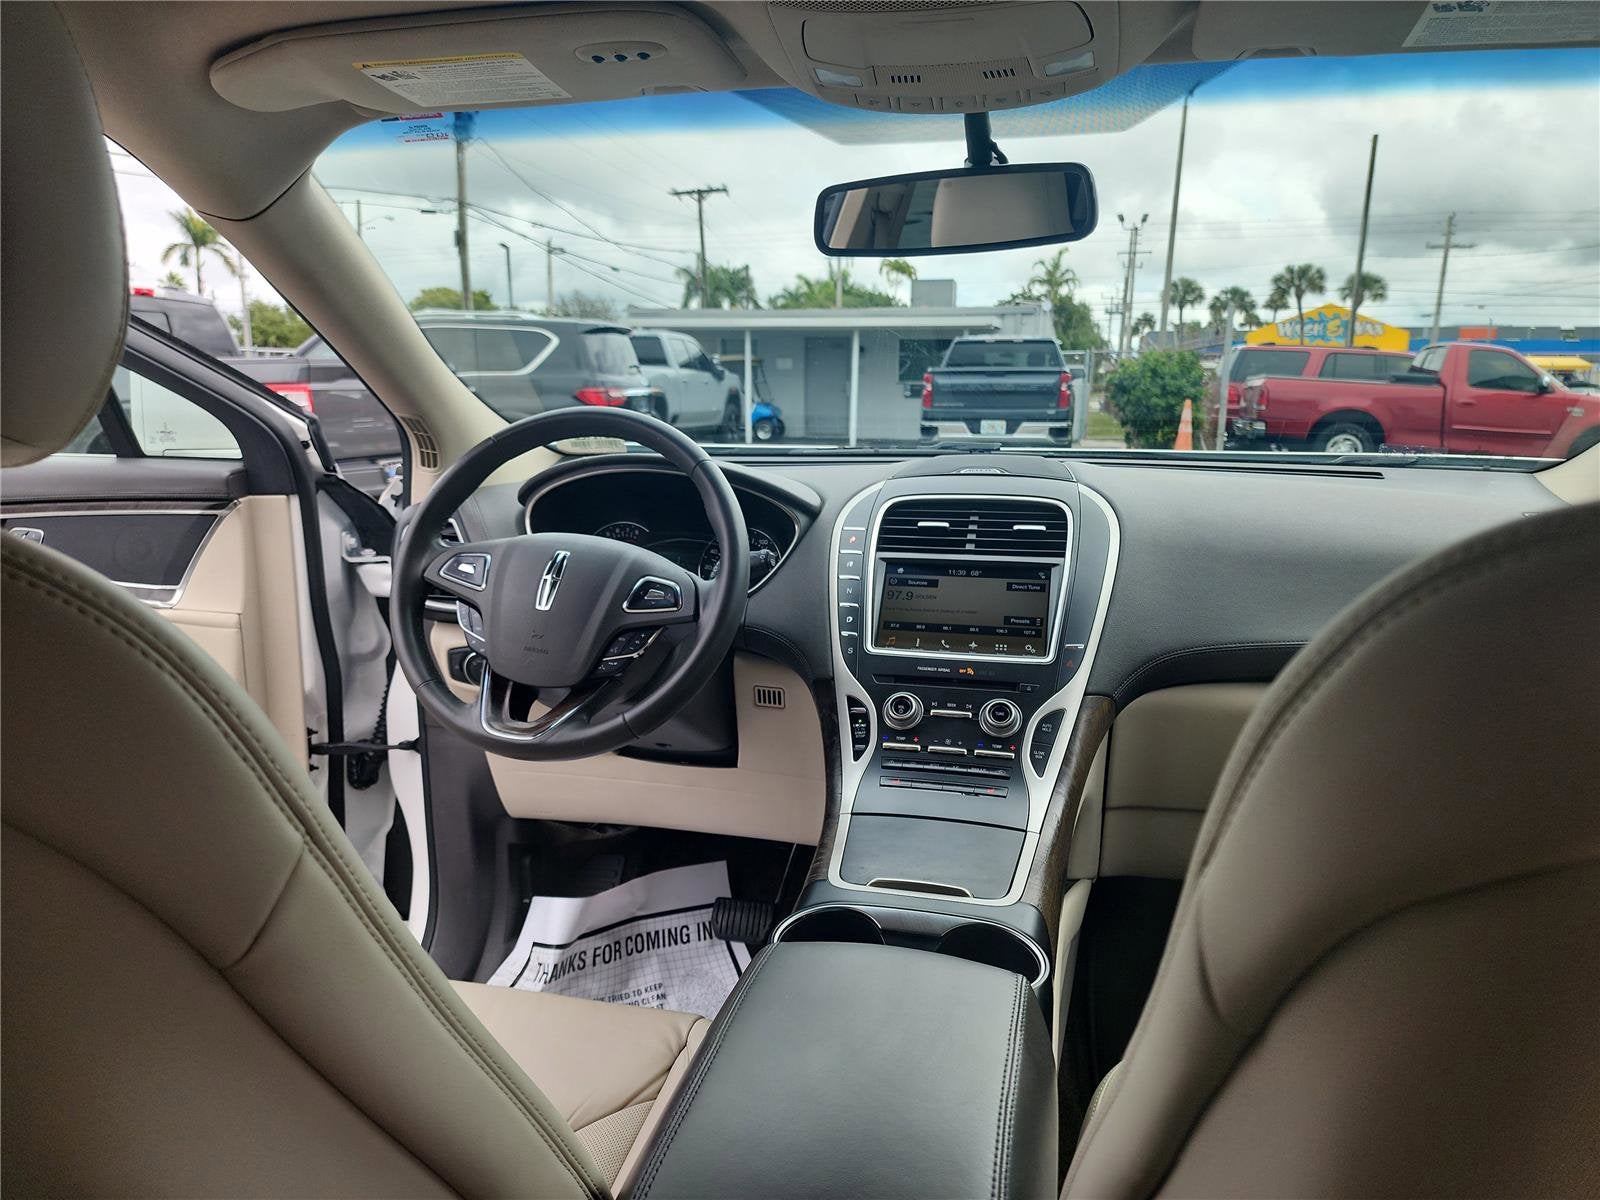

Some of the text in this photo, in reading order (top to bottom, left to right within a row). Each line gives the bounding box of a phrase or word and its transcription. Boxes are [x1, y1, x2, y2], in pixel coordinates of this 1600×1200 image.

[887, 590, 914, 601] 97.9
[533, 951, 588, 984] THANKS
[592, 940, 622, 968] FOR
[625, 925, 691, 956] COMING
[608, 992, 630, 1004] TRIED
[632, 989, 642, 997] TO
[644, 982, 663, 993] KEEP
